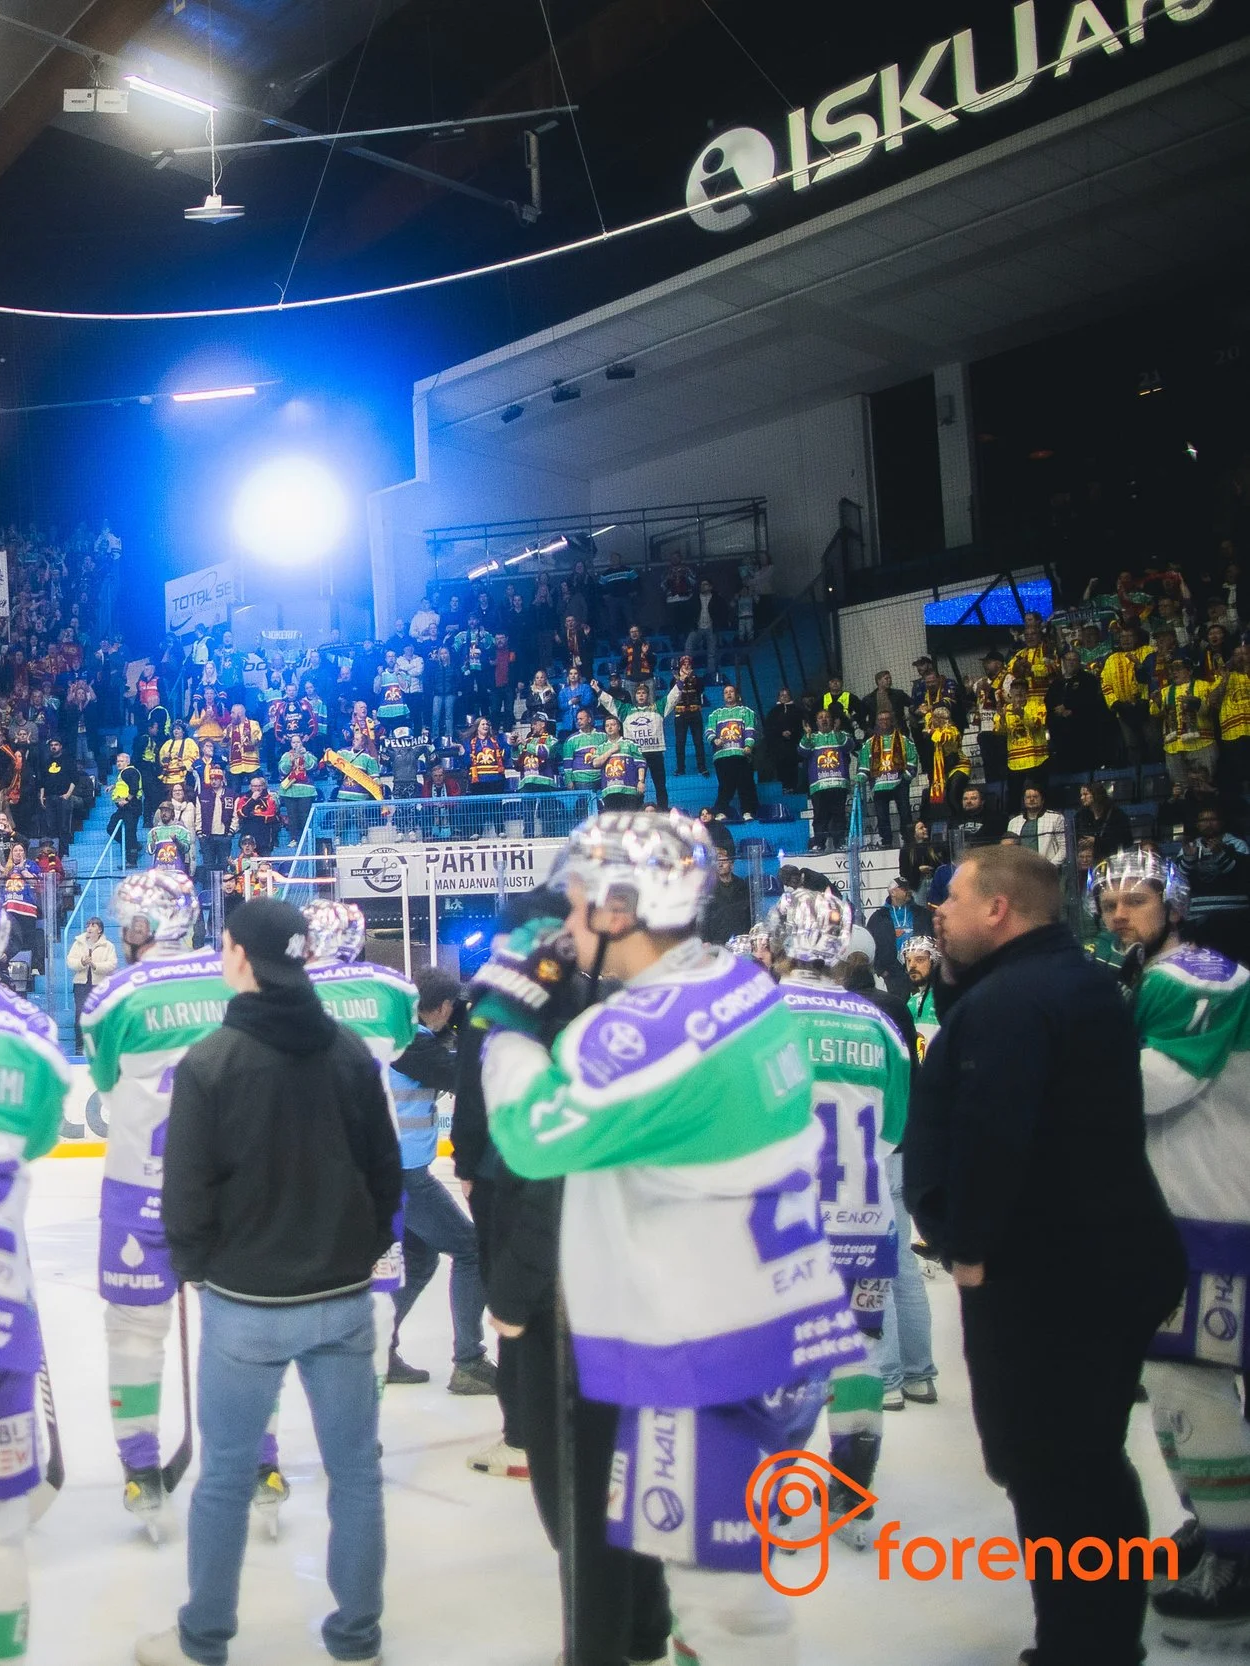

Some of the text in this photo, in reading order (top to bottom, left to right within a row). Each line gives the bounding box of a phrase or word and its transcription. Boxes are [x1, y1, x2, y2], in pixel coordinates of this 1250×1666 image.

[788, 0, 1038, 192] ISKU
[172, 588, 212, 612] TOTAL
[633, 728, 653, 738] TELE
[425, 843, 534, 874] PARTURI
[425, 880, 456, 891] IMAN
[836, 1210, 883, 1225] ENJOY
[855, 1255, 876, 1268] Oy
[102, 1271, 165, 1289] INFUEL
[772, 1258, 816, 1295] EAT
